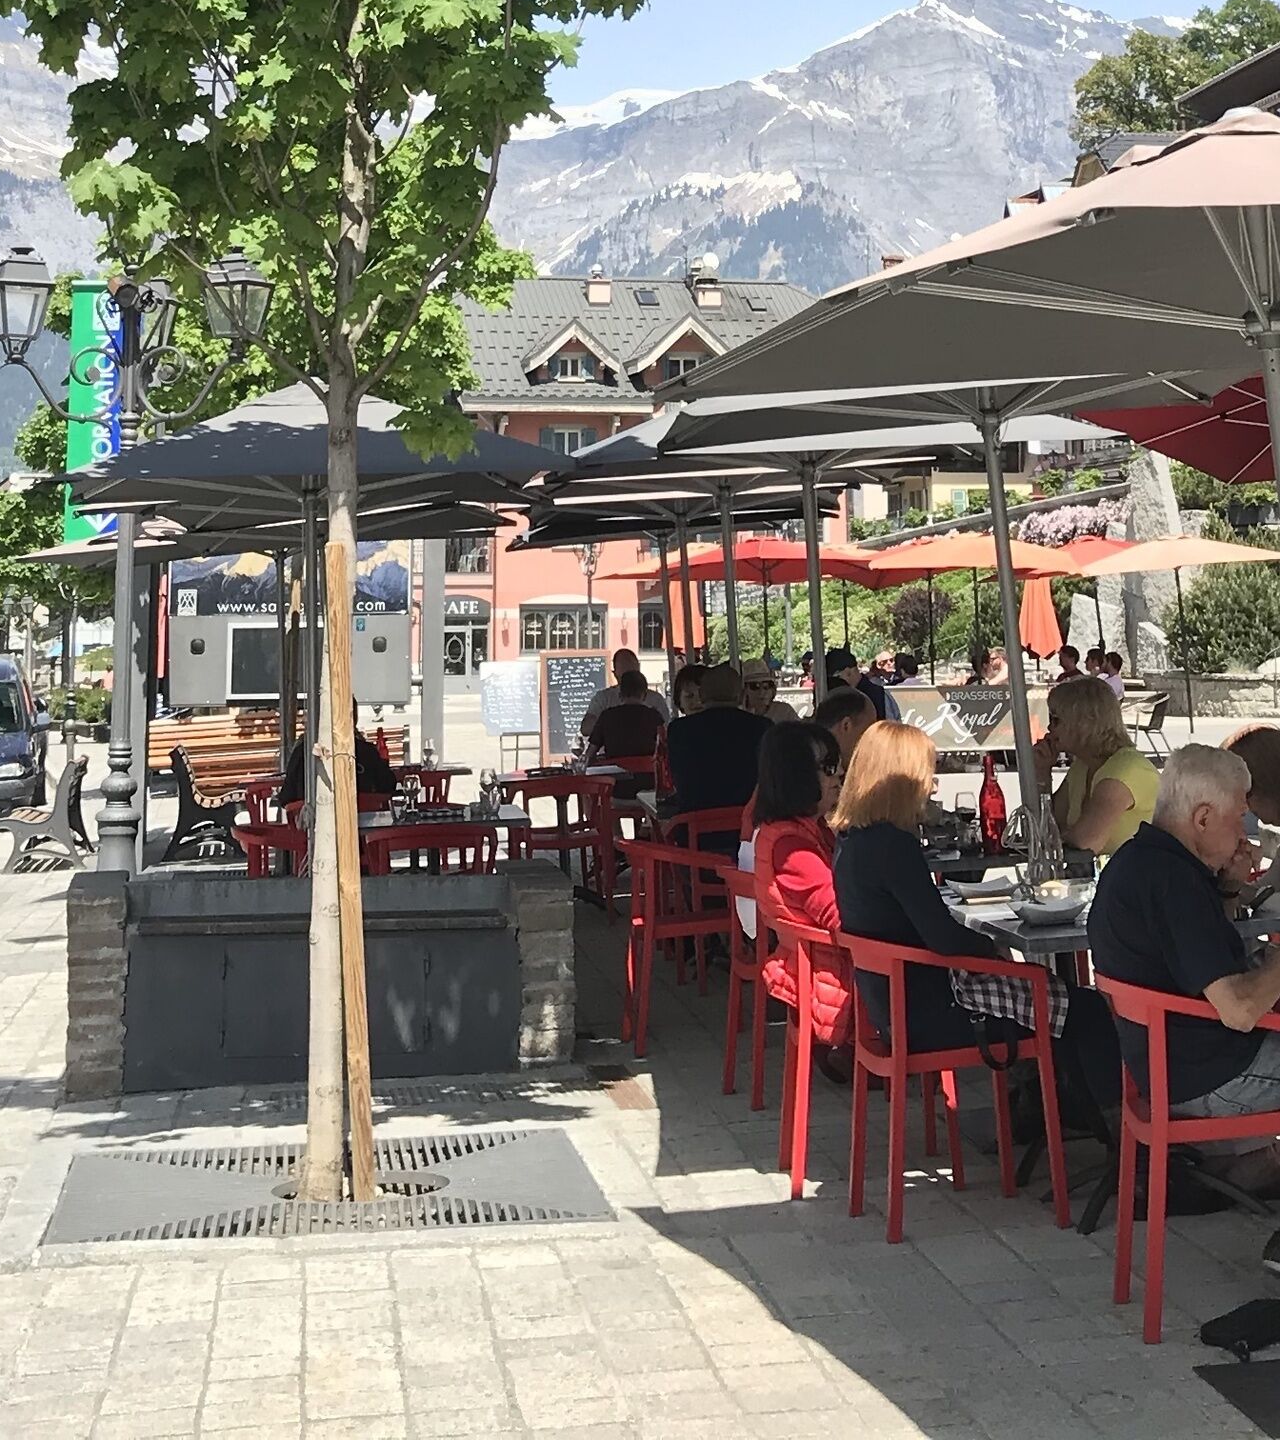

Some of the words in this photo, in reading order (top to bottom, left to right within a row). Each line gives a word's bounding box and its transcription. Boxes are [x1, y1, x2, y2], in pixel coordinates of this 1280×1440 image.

[443, 600, 479, 615] AFE
[950, 690, 1004, 701] BRASSERIE
[926, 702, 1004, 744] Royal
